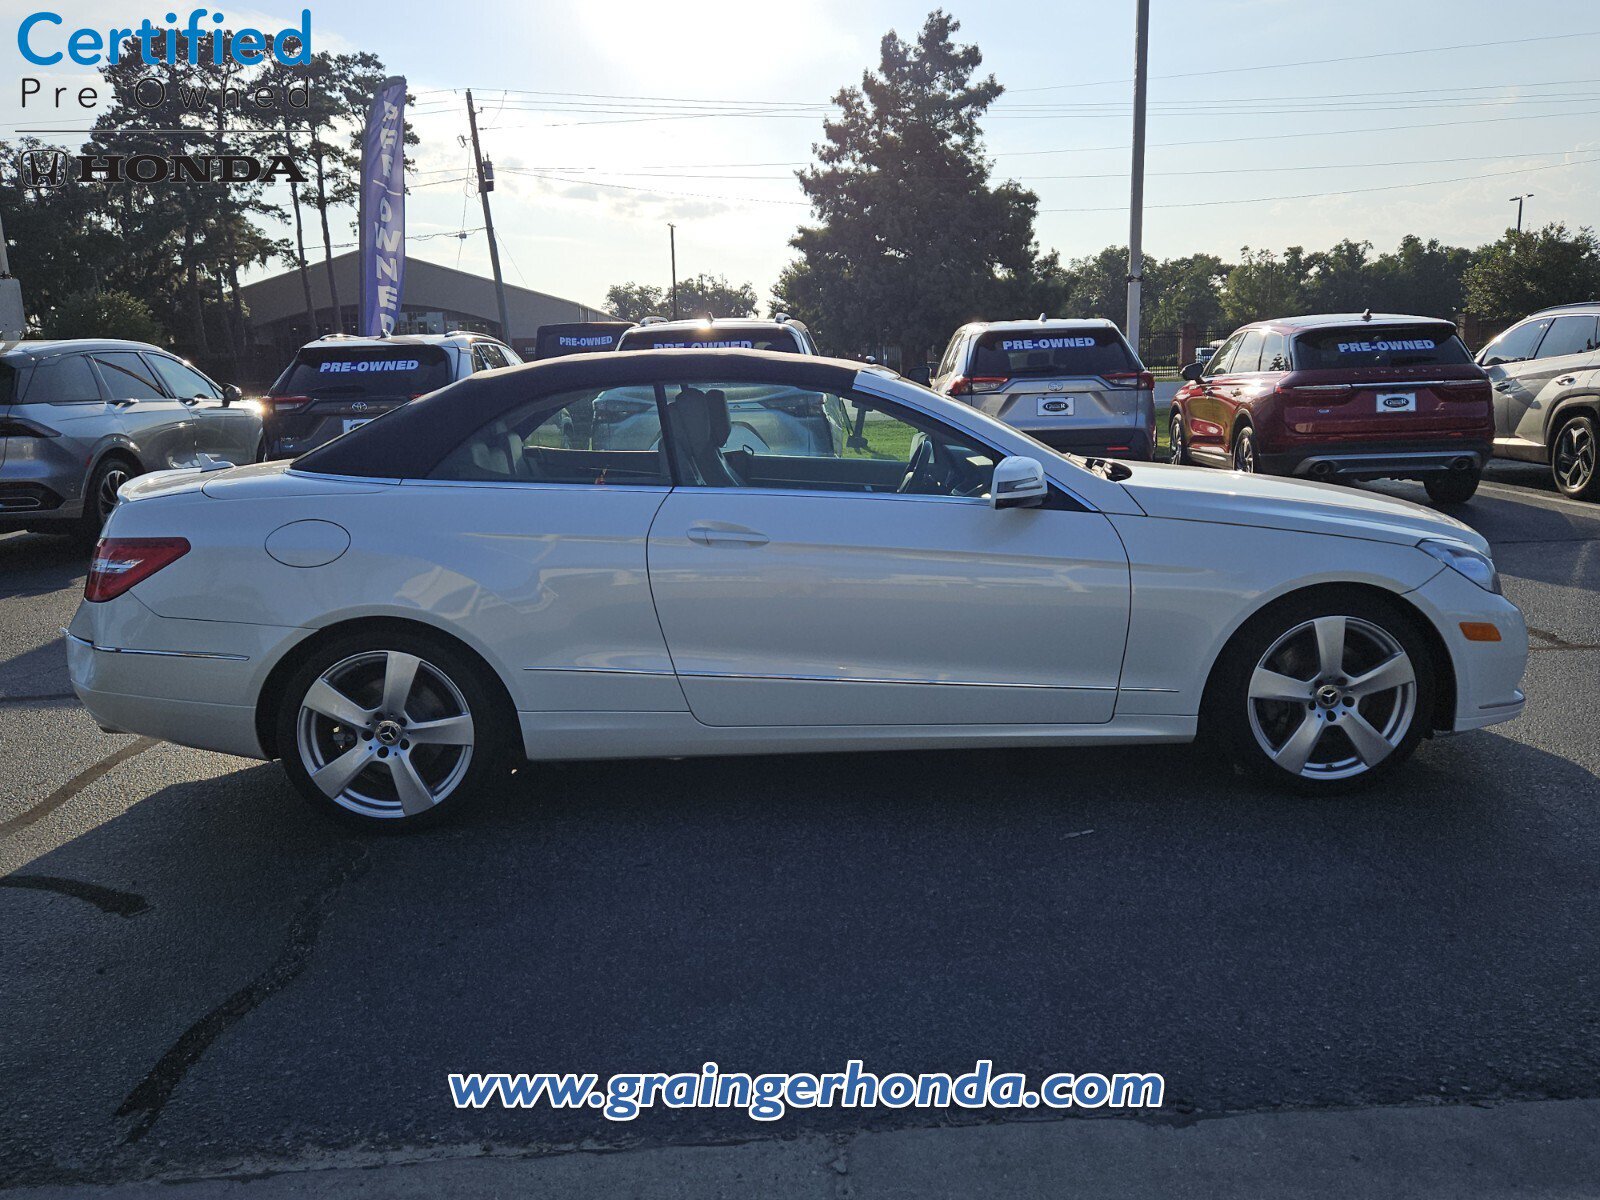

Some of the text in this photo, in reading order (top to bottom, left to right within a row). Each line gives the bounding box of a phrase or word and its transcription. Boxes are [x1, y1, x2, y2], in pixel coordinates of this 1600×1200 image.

[559, 336, 613, 346] PRE-OWNED
[1003, 337, 1095, 350] PRE-OWNED
[1338, 340, 1435, 352] PRE-OWNED
[320, 360, 419, 372] PRE-OWNED
